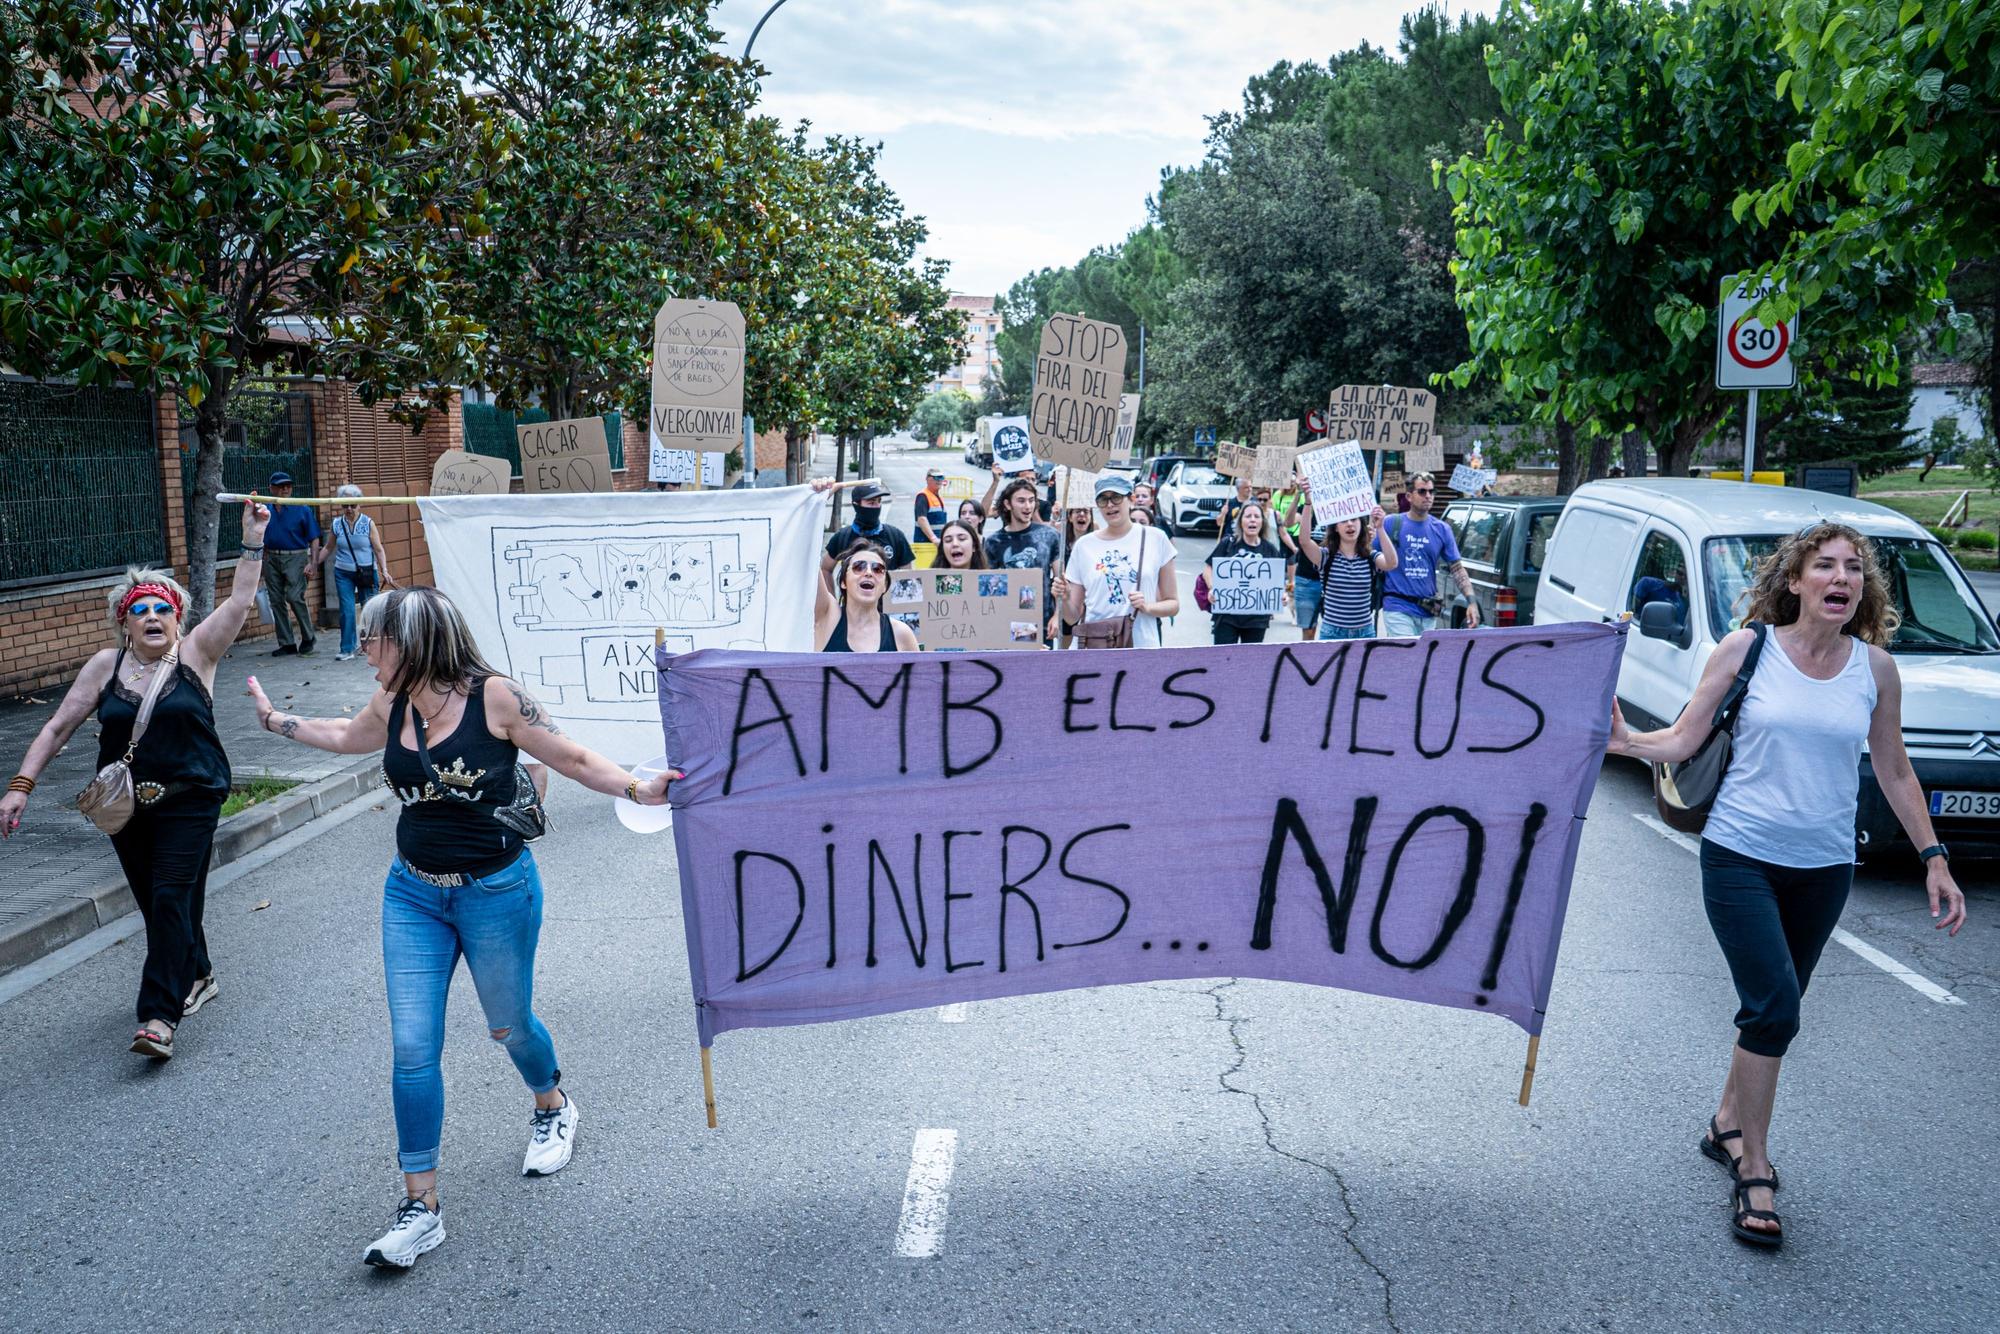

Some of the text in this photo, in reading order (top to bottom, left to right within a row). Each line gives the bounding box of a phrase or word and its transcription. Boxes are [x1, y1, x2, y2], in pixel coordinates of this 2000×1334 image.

[668, 327, 680, 337] NO
[685, 328, 691, 337] A
[697, 329, 707, 338] LA
[1046, 316, 1119, 365] STOP
[1741, 329, 1775, 350] 30
[667, 346, 679, 355] DEL
[722, 349, 728, 357] A
[667, 359, 689, 369] SANT
[673, 374, 713, 384] DE BAGES
[1037, 358, 1107, 400] FIRA DEL
[1341, 386, 1428, 408] LA CAÇA NI
[654, 407, 736, 435] VERGONYA!
[1032, 392, 1116, 451] CAÇADOR
[1330, 402, 1408, 421] ESPORT NI
[522, 424, 579, 459] CAÇAR
[1114, 426, 1133, 450] NO
[1327, 419, 1430, 447] FESTA A SFB
[653, 449, 709, 467] BATANS
[443, 470, 482, 484] NO A LA
[538, 463, 561, 490] ÉS
[1216, 560, 1272, 580] CAÇA
[927, 599, 996, 618] NO A LA
[941, 623, 977, 640] CAZA
[603, 641, 657, 667] AIX
[619, 670, 656, 696] NO
[723, 639, 1554, 796] AMB ELS MEUS
[1944, 795, 2000, 815] 2039
[1250, 796, 1548, 1007] NO!
